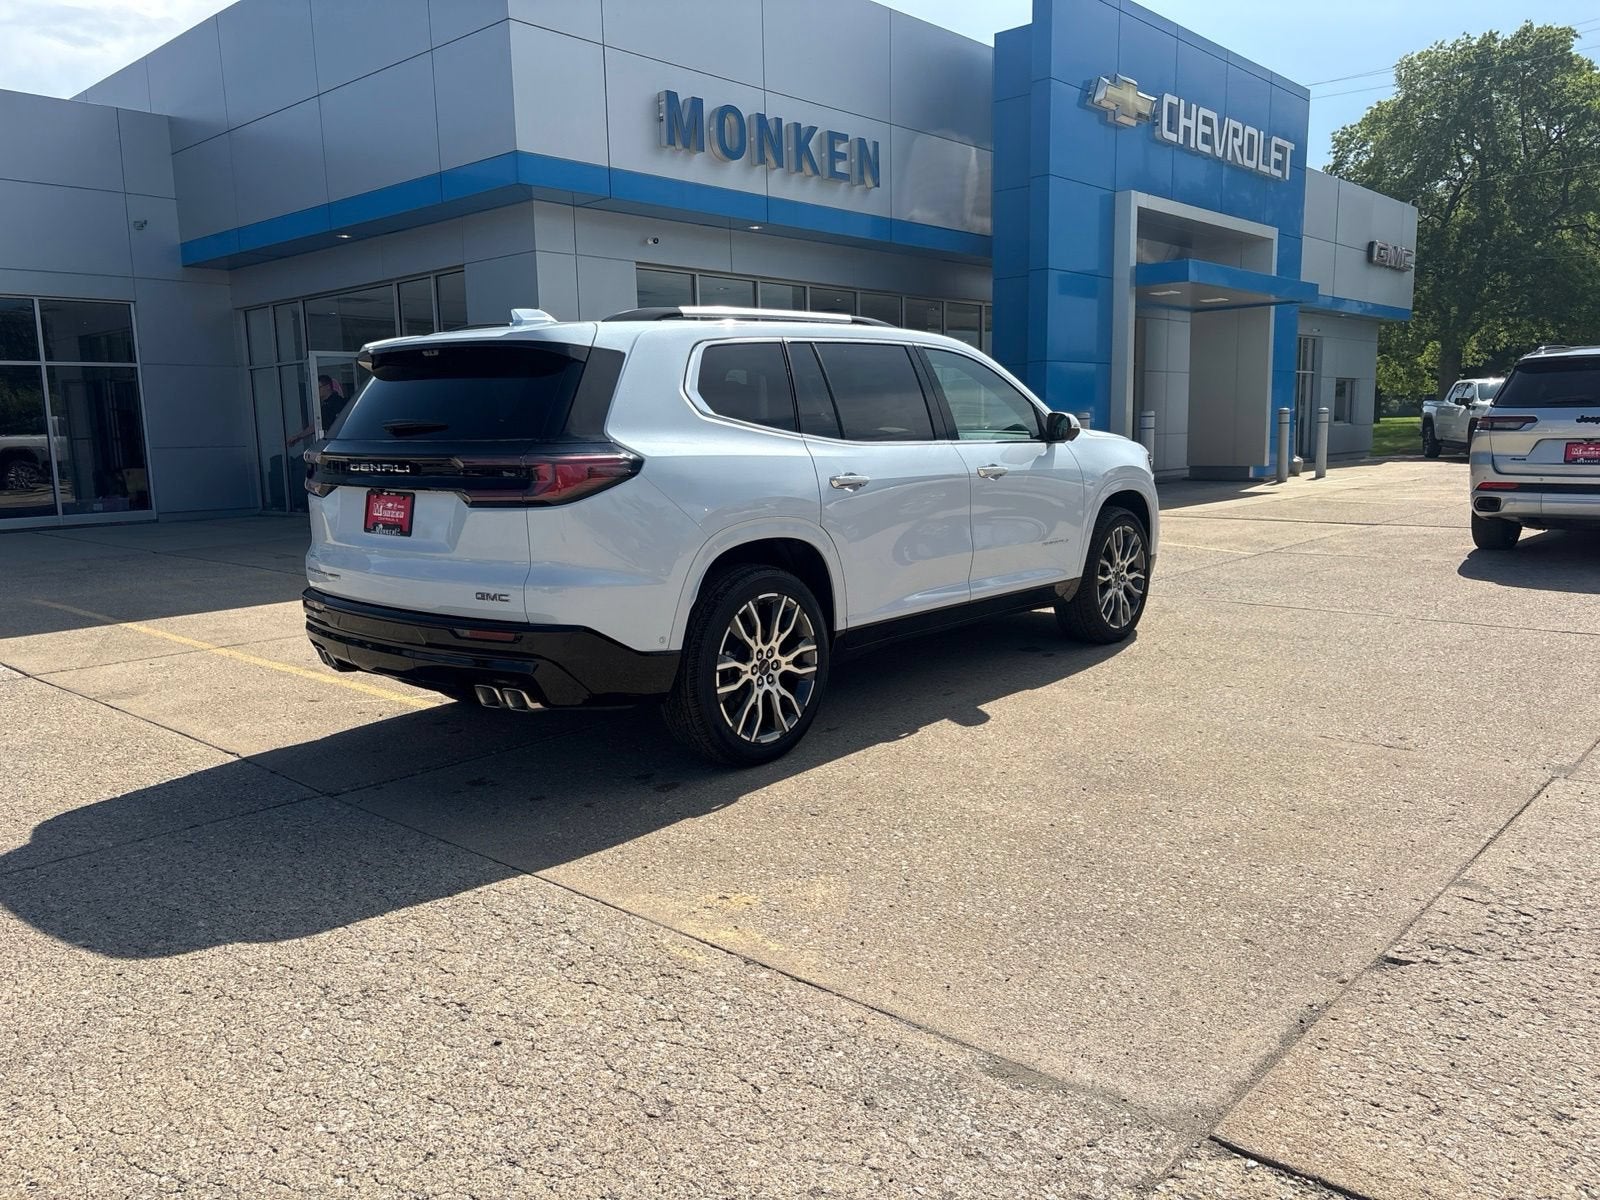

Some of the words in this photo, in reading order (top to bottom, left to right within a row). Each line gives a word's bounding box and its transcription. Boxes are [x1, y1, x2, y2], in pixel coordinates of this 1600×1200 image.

[657, 90, 880, 188] MONKEN
[1157, 92, 1295, 181] CHEVROLET
[1368, 240, 1414, 271] GMC
[350, 463, 410, 473] DENALI
[475, 591, 511, 603] GMC
